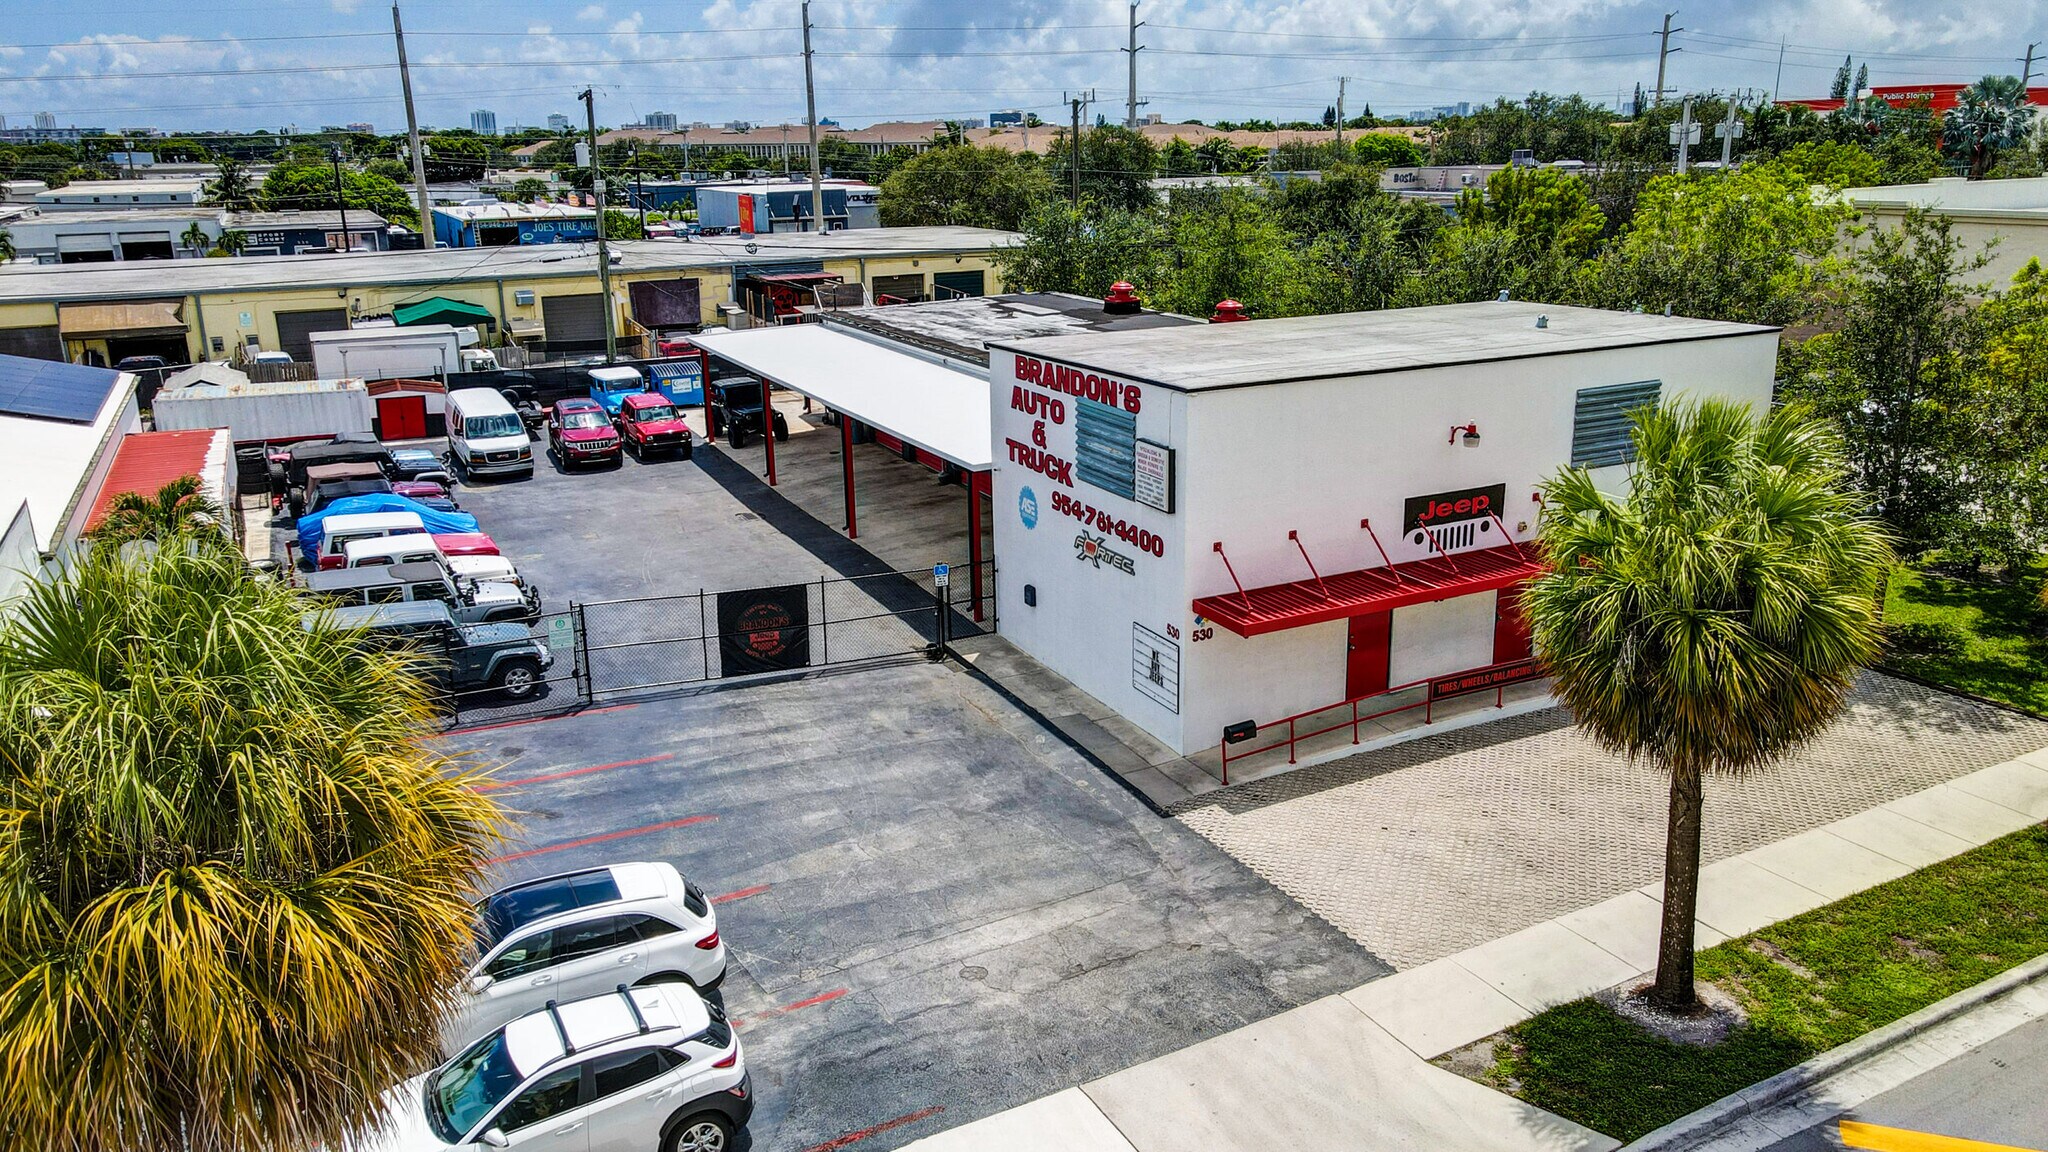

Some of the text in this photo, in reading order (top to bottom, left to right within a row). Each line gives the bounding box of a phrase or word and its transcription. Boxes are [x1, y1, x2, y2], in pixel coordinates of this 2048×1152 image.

[533, 222, 554, 232] JOES
[557, 221, 578, 232] TIRE
[1015, 355, 1142, 414] BRANDON'S
[1011, 385, 1065, 425] AUTO
[1032, 420, 1047, 449] &
[1005, 437, 1074, 488] TRUCK
[1418, 495, 1490, 520] Jeep
[1166, 623, 1180, 640] 530
[1192, 627, 1213, 642] 530
